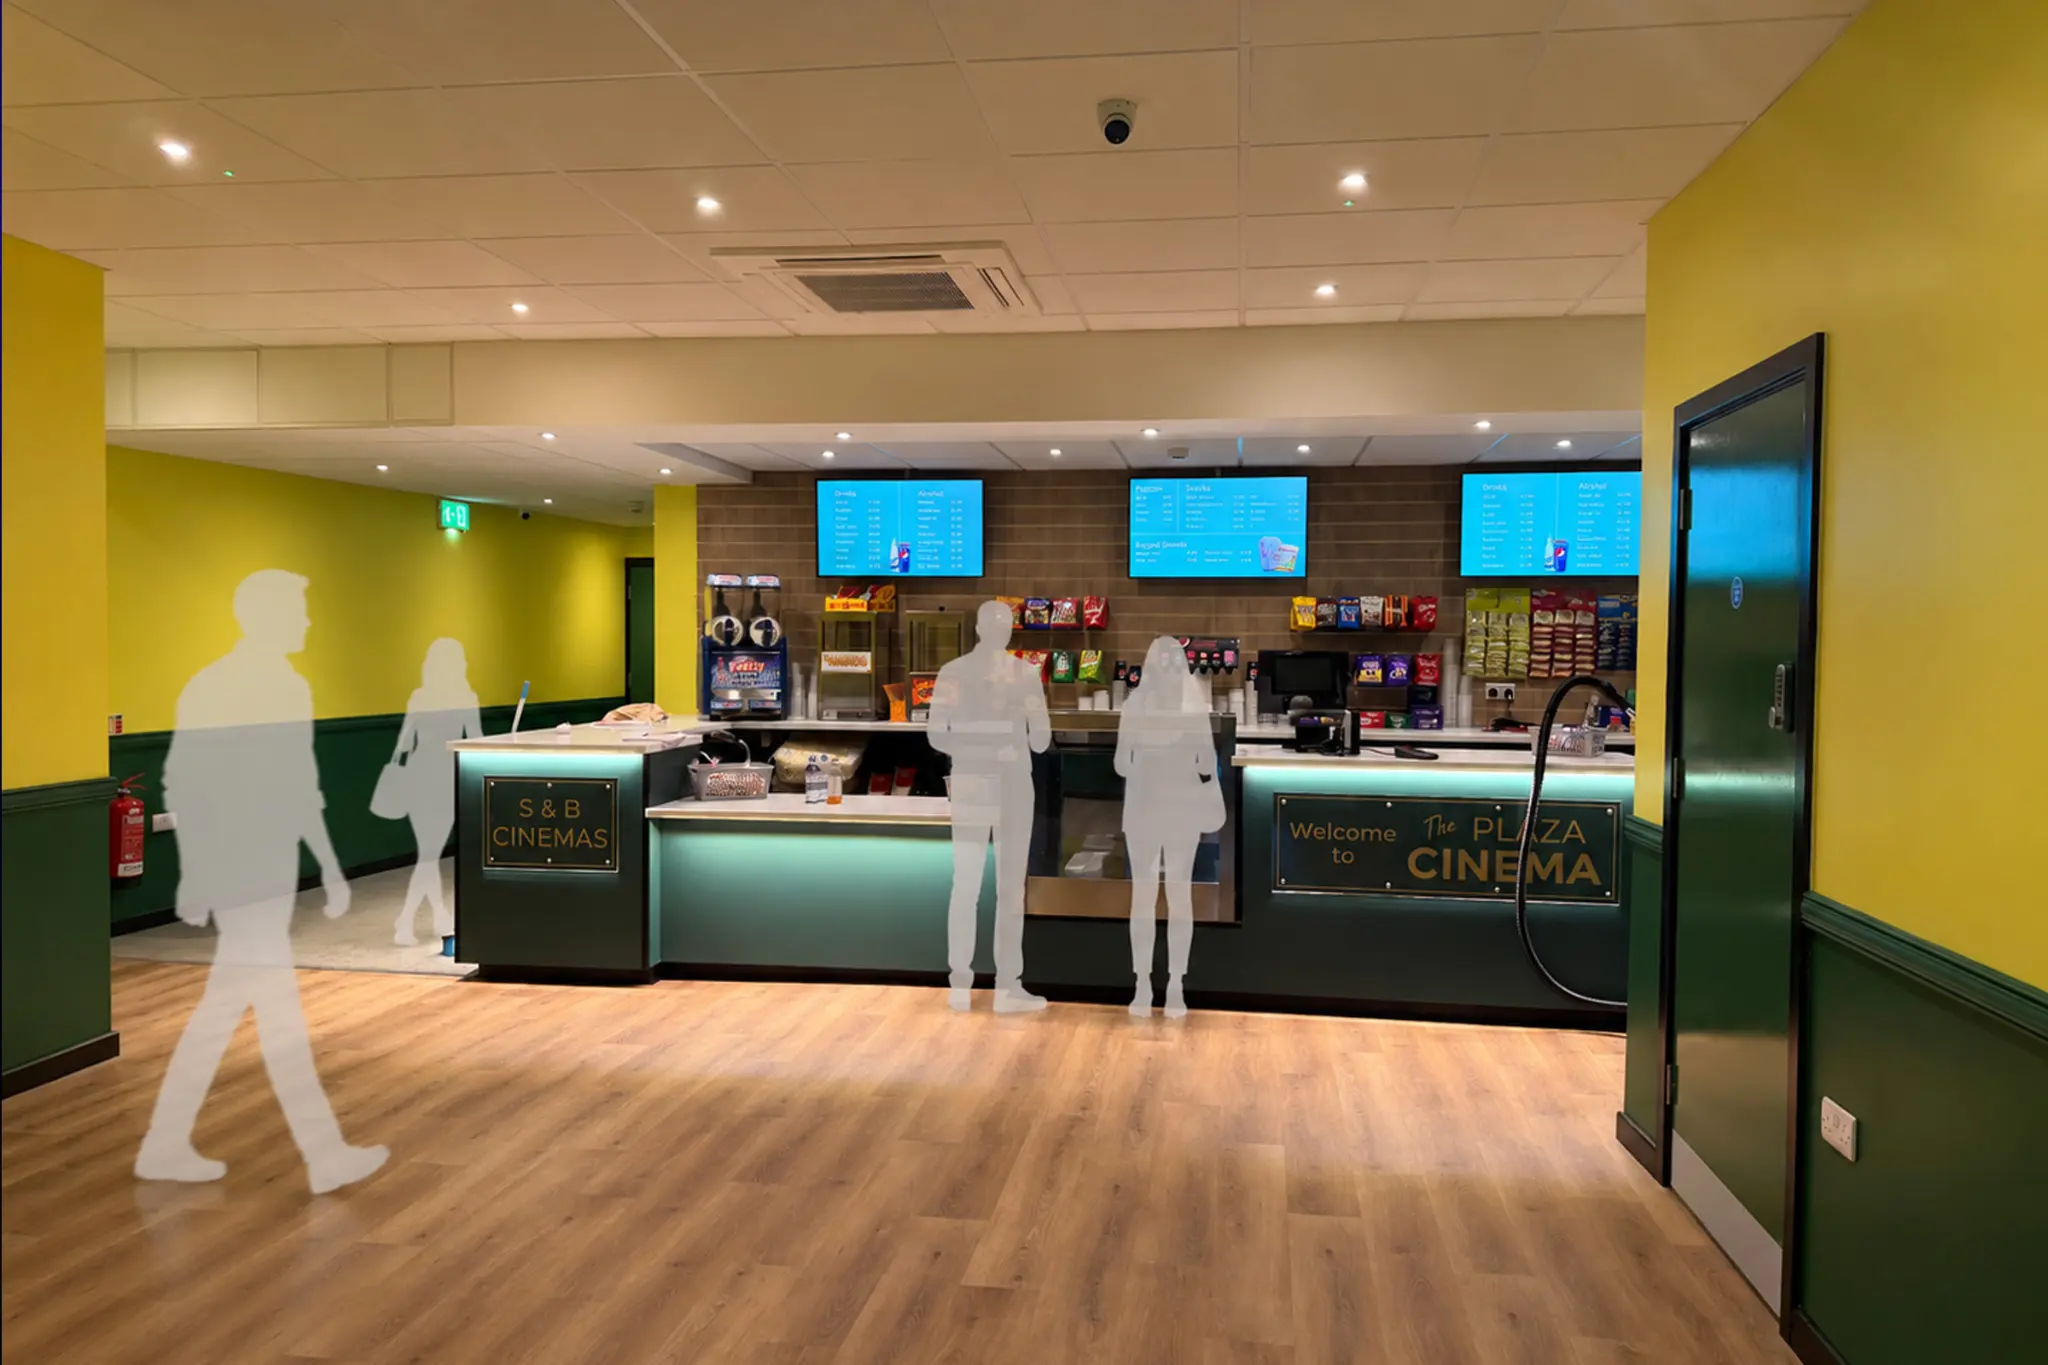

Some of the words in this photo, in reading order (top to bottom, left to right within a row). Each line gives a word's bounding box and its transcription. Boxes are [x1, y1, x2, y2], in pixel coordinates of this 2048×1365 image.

[519, 798, 534, 818] S
[541, 798, 556, 818] &
[564, 799, 581, 819] B
[492, 826, 609, 849] CINEMAS
[1289, 822, 1397, 842] Welcome
[1423, 813, 1457, 841] The
[1331, 847, 1355, 864] to
[1407, 846, 1602, 886] CINEMA
